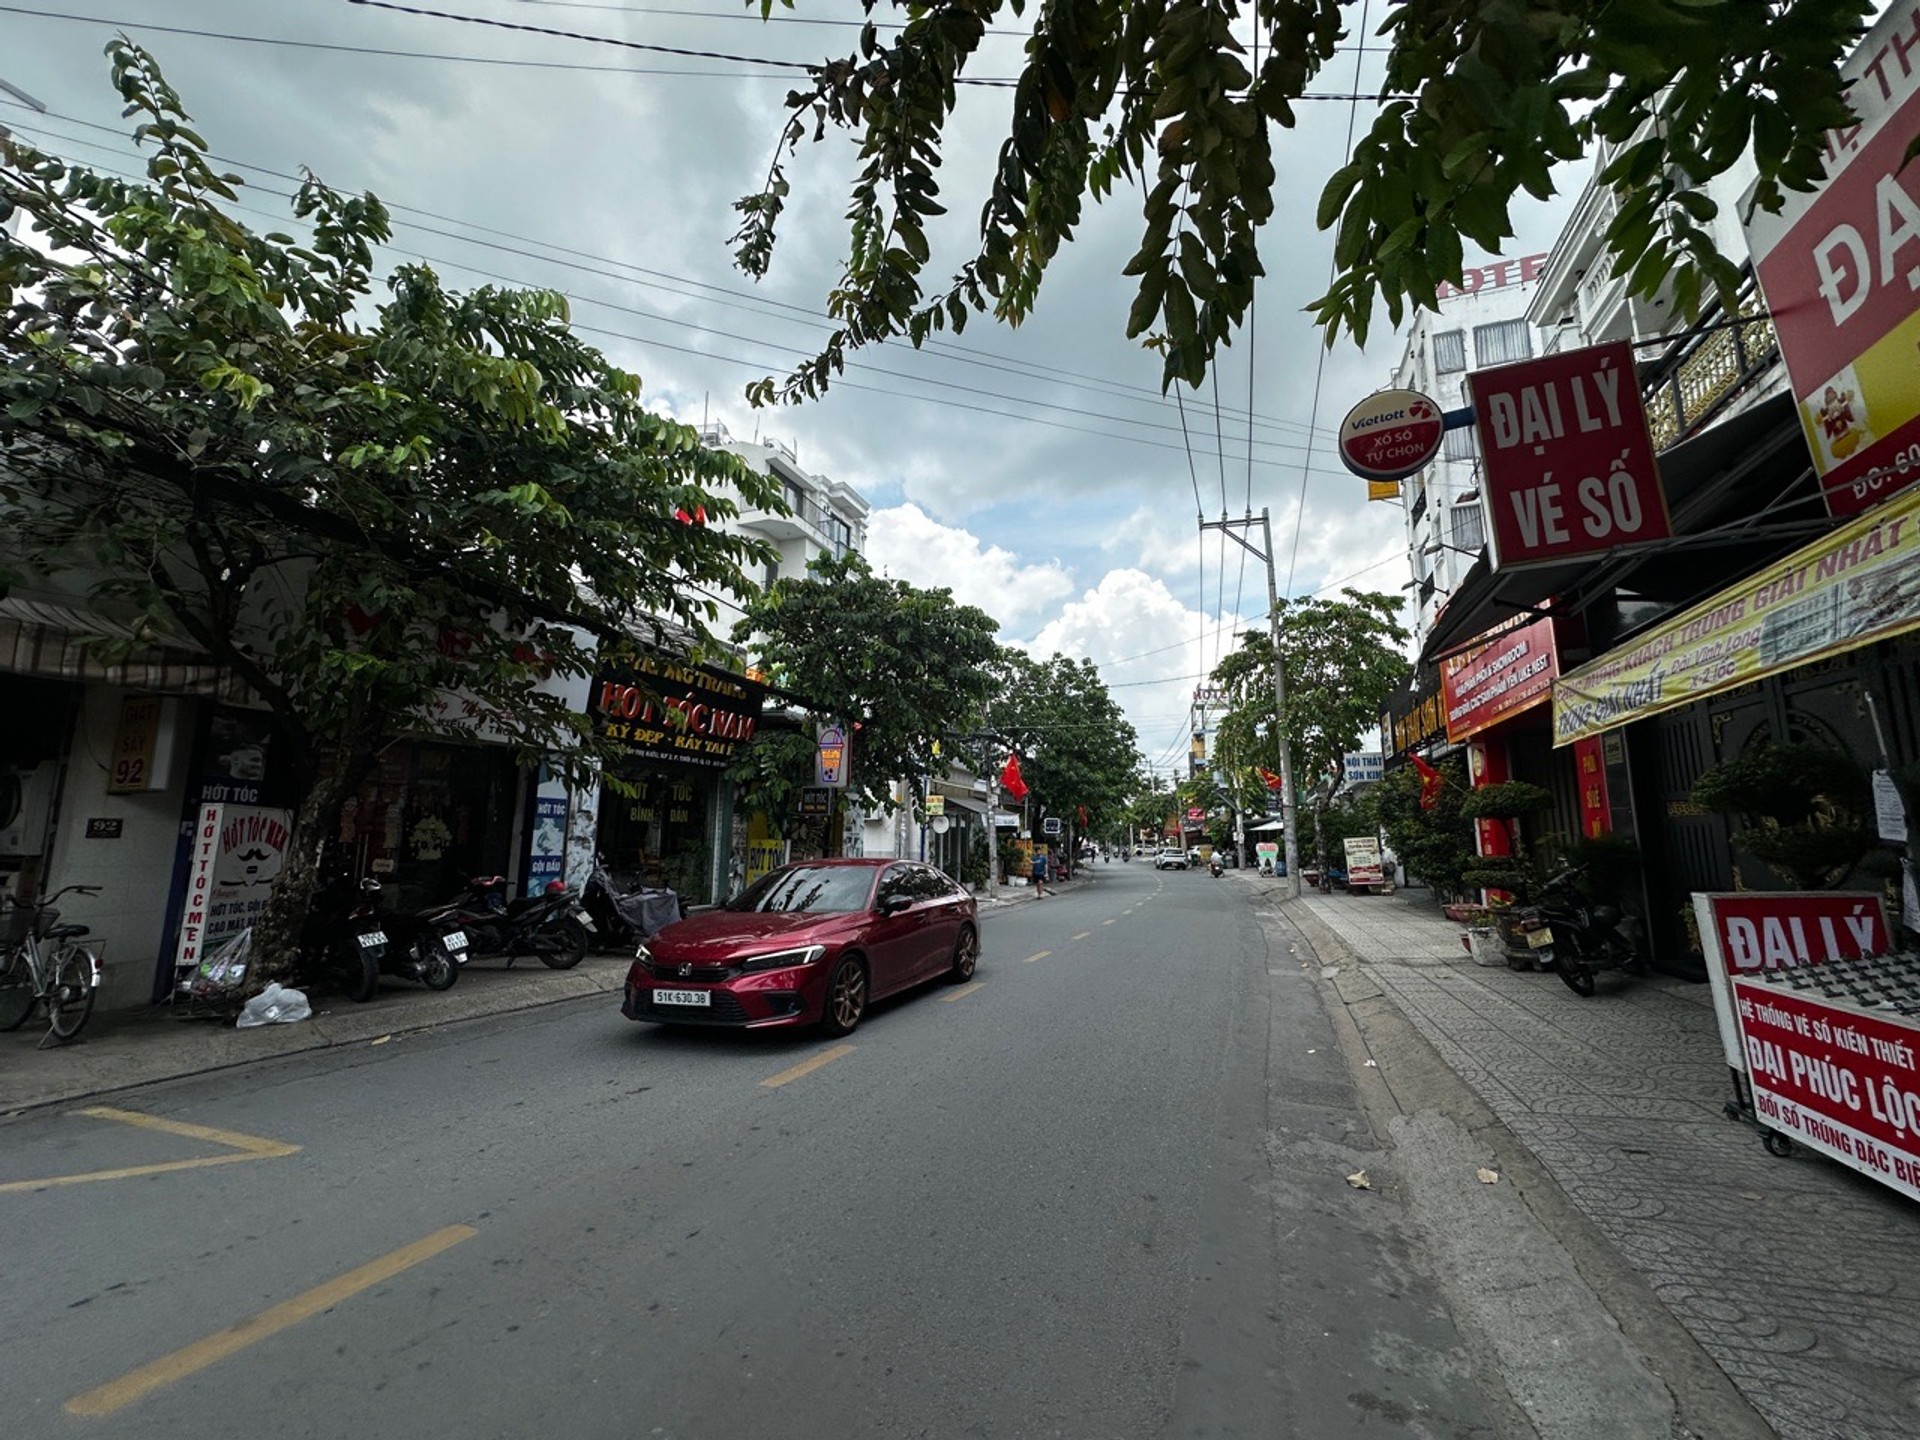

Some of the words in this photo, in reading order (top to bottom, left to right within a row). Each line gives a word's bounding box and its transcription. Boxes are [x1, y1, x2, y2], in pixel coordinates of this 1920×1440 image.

[1489, 382, 1564, 455] ĐẠI
[1571, 356, 1622, 433] LÝ
[1352, 410, 1405, 430] Vietlott
[1395, 427, 1413, 442] SỐ
[1365, 449, 1384, 464] TỰ
[1386, 443, 1425, 459] CHỌN
[1510, 472, 1570, 548] VÉ
[1578, 448, 1643, 538] SỐ
[1815, 516, 1908, 582] NHẤT
[1725, 627, 1761, 654] Long
[1492, 641, 1528, 674] SHOWROOM
[1623, 660, 1667, 711] NHẤT
[663, 691, 709, 733] TÓC
[709, 707, 758, 741] NAM
[634, 727, 664, 747] ĐẸP
[675, 733, 702, 752] RÁY
[705, 740, 725, 755] TAI
[116, 758, 144, 784] 92
[1346, 756, 1360, 768] NỘI
[1362, 755, 1382, 767] THẤT
[1348, 770, 1364, 781] SƠN
[1367, 770, 1383, 780] KIM
[202, 782, 229, 801] HỚT
[233, 785, 259, 803] TÓC
[553, 802, 566, 815] TÓC
[630, 803, 655, 822] BÌNH
[92, 820, 118, 831] 92
[203, 810, 216, 854] HỚT
[223, 817, 244, 854] HỚT
[532, 859, 545, 873] GỘI
[545, 858, 560, 872] ĐẦU
[194, 860, 208, 906] TÓC
[210, 902, 228, 916] HỚT
[657, 991, 706, 1004] 51K-630.38
[1740, 997, 1754, 1023] HỆ
[1754, 1001, 1794, 1034] THỐNG
[1793, 1012, 1811, 1035] VÉ
[1811, 1017, 1832, 1043] SỐ
[1832, 1024, 1870, 1057] KIẾN
[1870, 1037, 1916, 1071] THIẾT
[1748, 1034, 1787, 1084] ĐẠI
[1790, 1054, 1861, 1112] PHÚC
[1757, 1092, 1781, 1118] ĐỔI
[1782, 1104, 1801, 1129] SỐ
[1802, 1112, 1853, 1156] TRÚNG
[1855, 1138, 1889, 1172] ĐẶC
